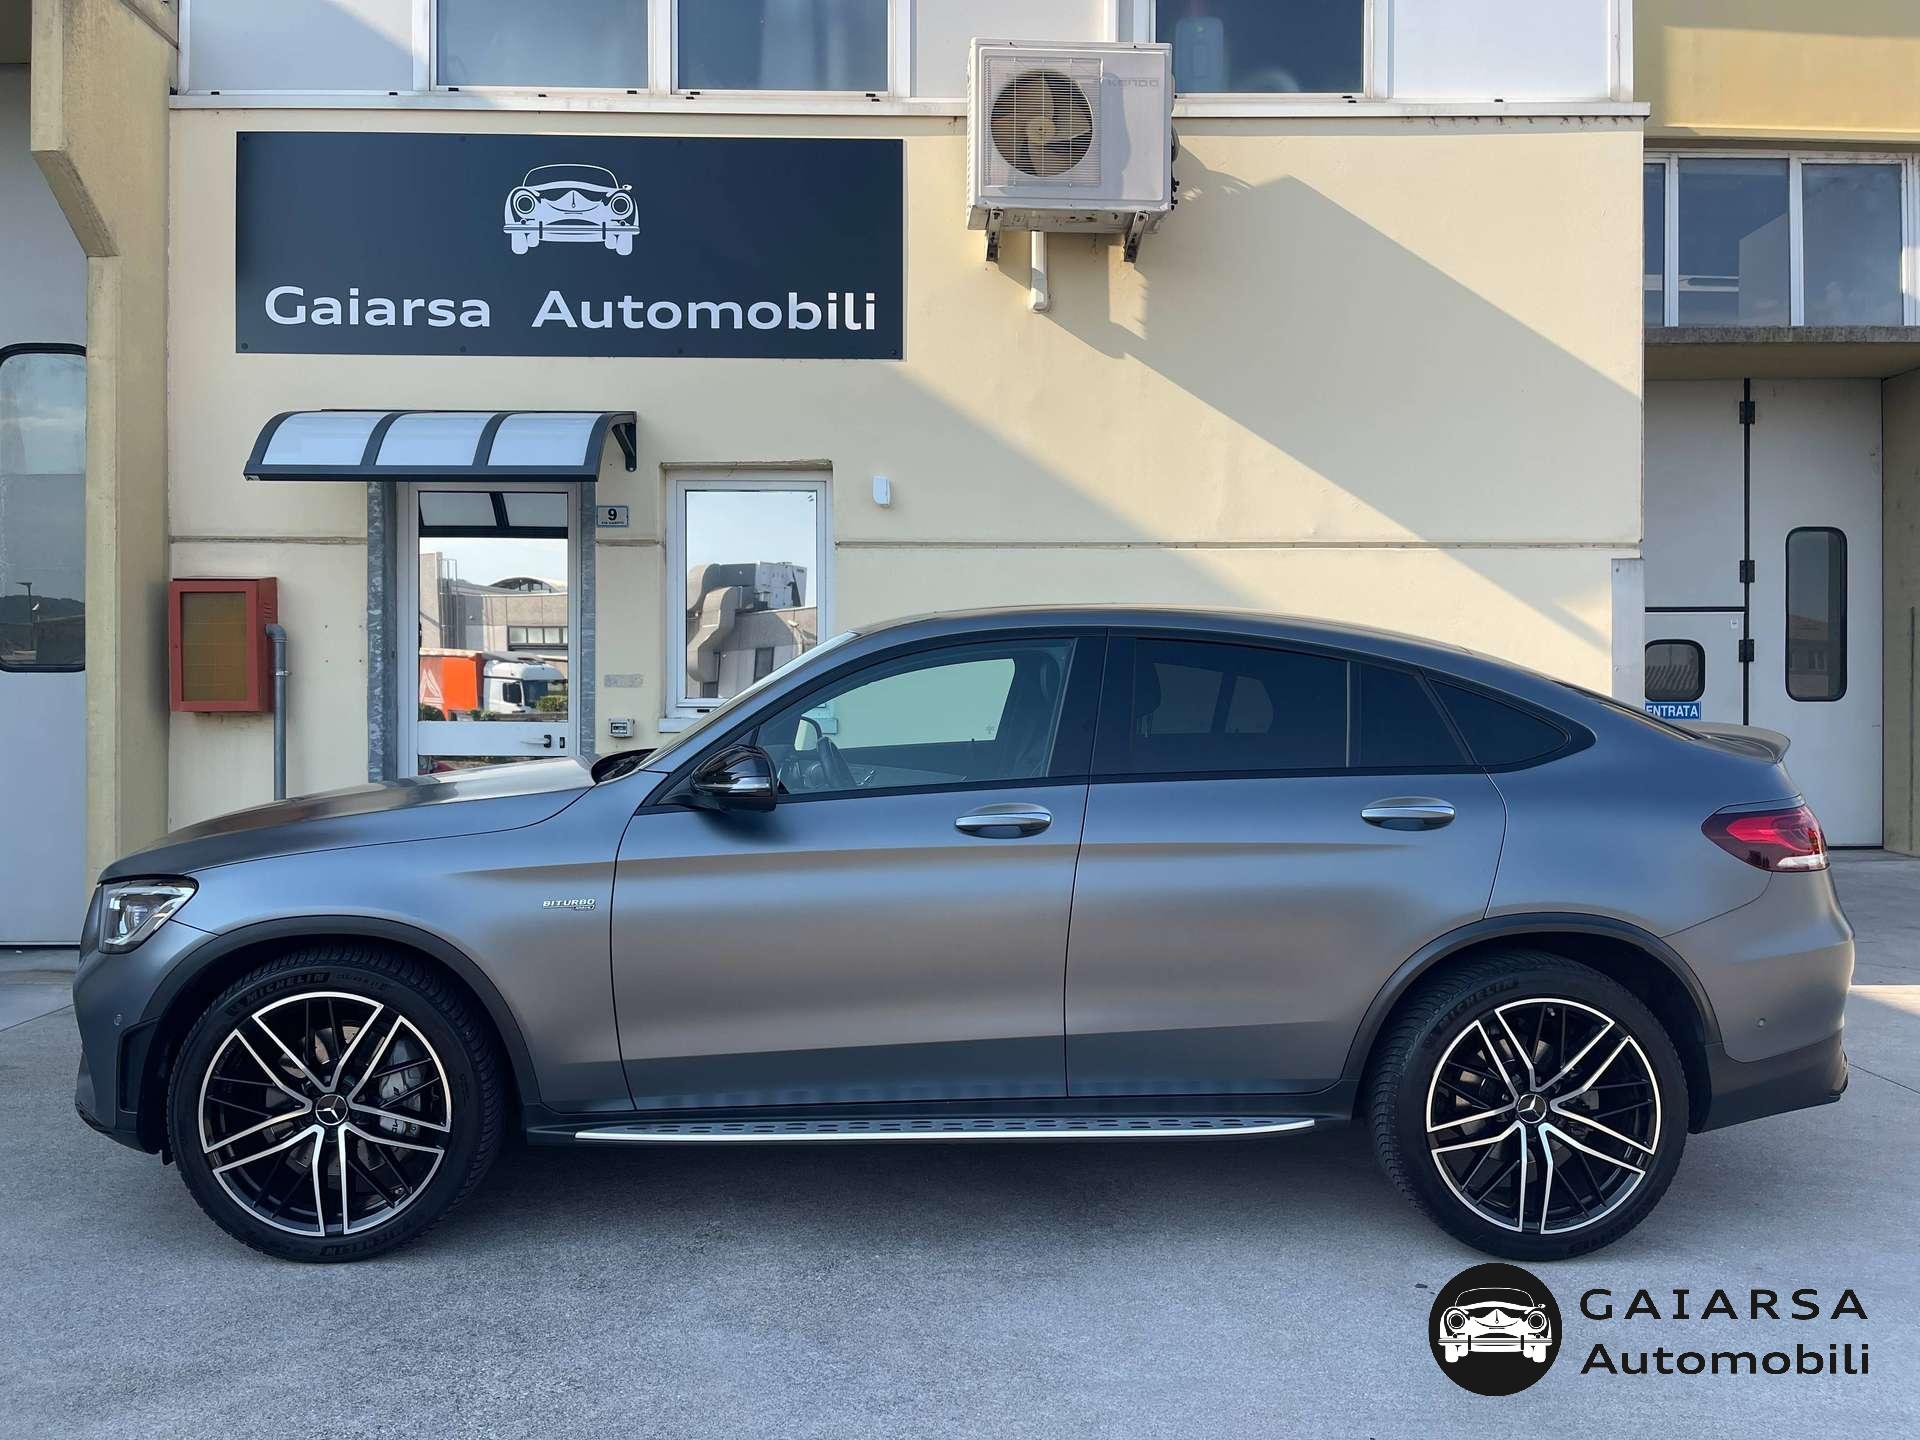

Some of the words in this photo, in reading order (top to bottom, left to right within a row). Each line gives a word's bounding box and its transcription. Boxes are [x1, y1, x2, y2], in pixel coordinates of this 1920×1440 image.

[265, 286, 490, 328] Gaiarsa
[532, 291, 876, 331] Automobili
[608, 508, 618, 521] 9
[1646, 705, 1698, 717] ENTRATA
[543, 898, 595, 907] BITURBO
[246, 973, 325, 1002] MICHELIN
